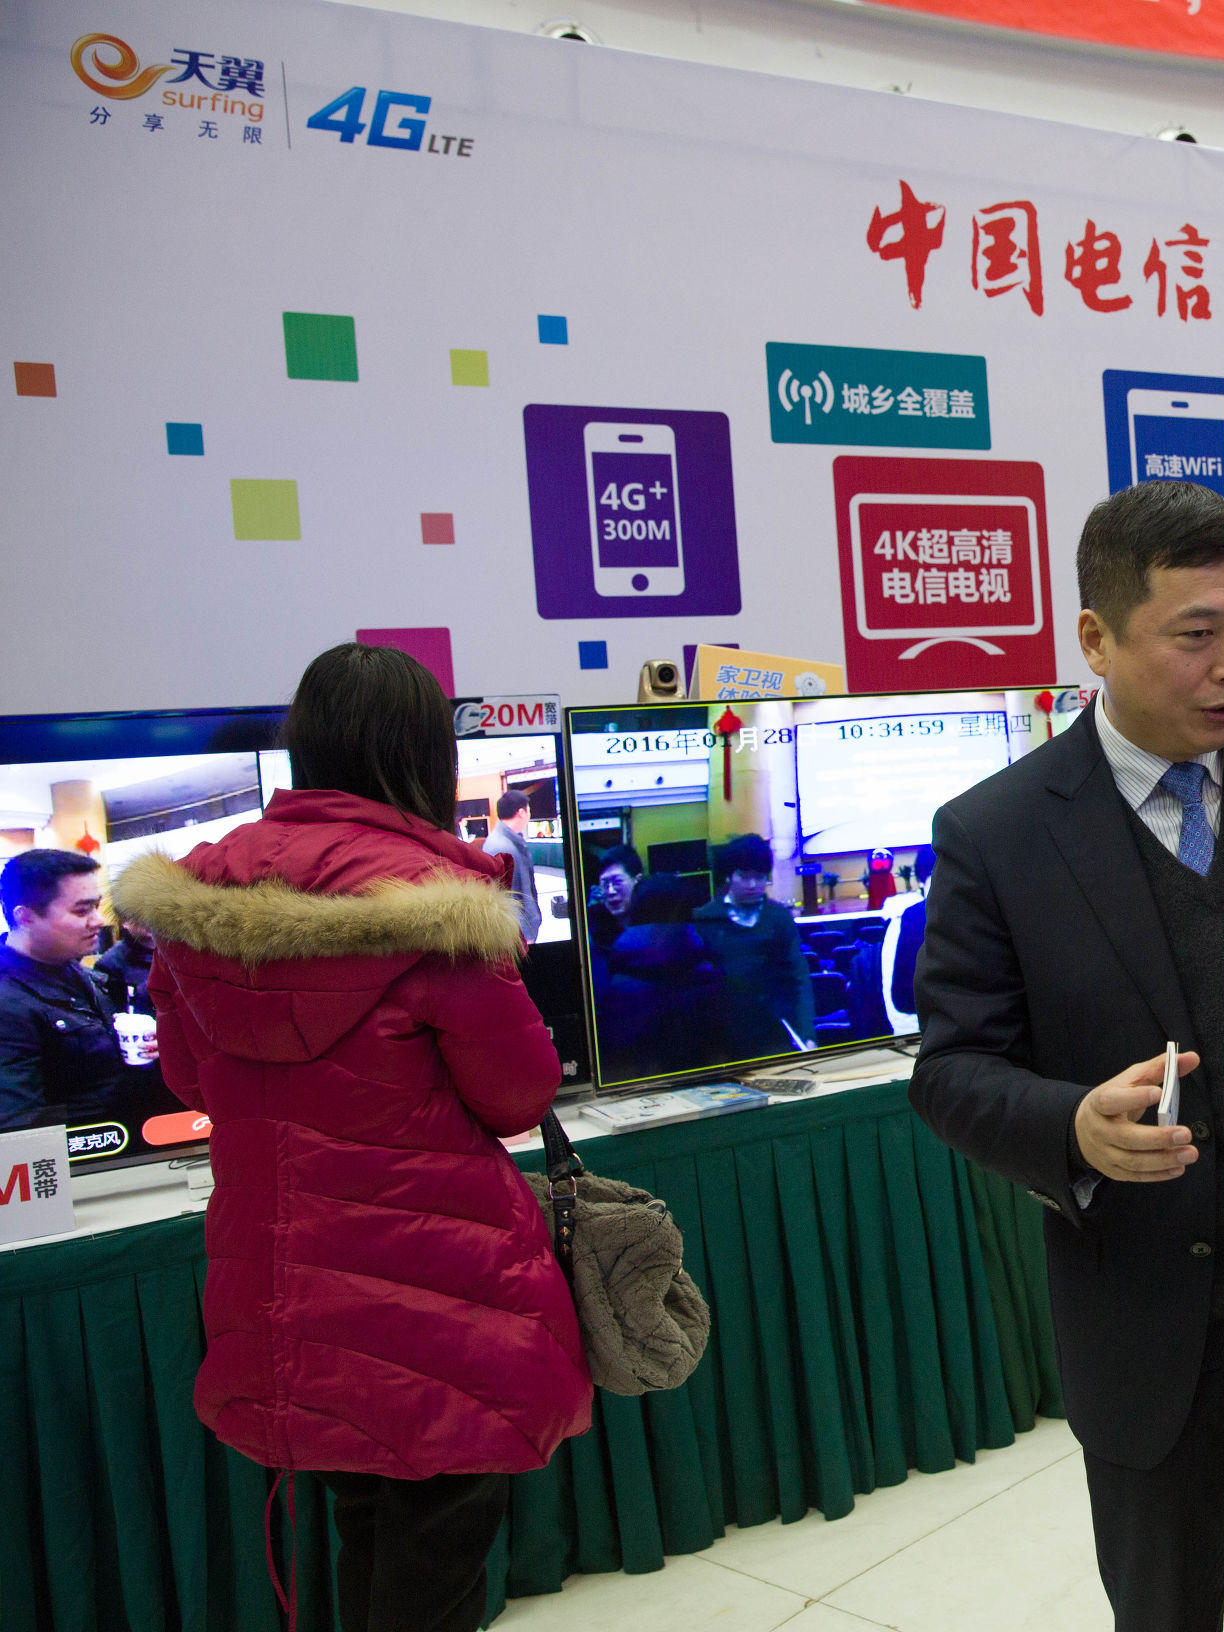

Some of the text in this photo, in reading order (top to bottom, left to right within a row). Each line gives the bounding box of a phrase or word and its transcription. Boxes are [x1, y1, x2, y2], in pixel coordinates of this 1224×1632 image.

[166, 47, 266, 98] 天翼
[162, 90, 264, 122] surfing
[306, 86, 475, 158] 4G LTE
[89, 106, 264, 145] 分享无限
[866, 179, 1211, 322] 中国电信
[841, 384, 976, 419] 城乡全覆盖
[1145, 453, 1223, 478] 高速WiFi
[600, 481, 668, 511] 4G+
[603, 519, 671, 540] 300M
[873, 528, 1013, 565] 4K超高清
[882, 566, 1012, 604] 电信电视
[715, 664, 784, 691] 家卫视
[716, 687, 784, 700] 体验
[479, 703, 544, 728] 20M
[838, 719, 944, 740] 10:34:59
[959, 713, 1032, 738] 星期四
[68, 1130, 121, 1153] 麦克风
[32, 1158, 58, 1199] 宽带
